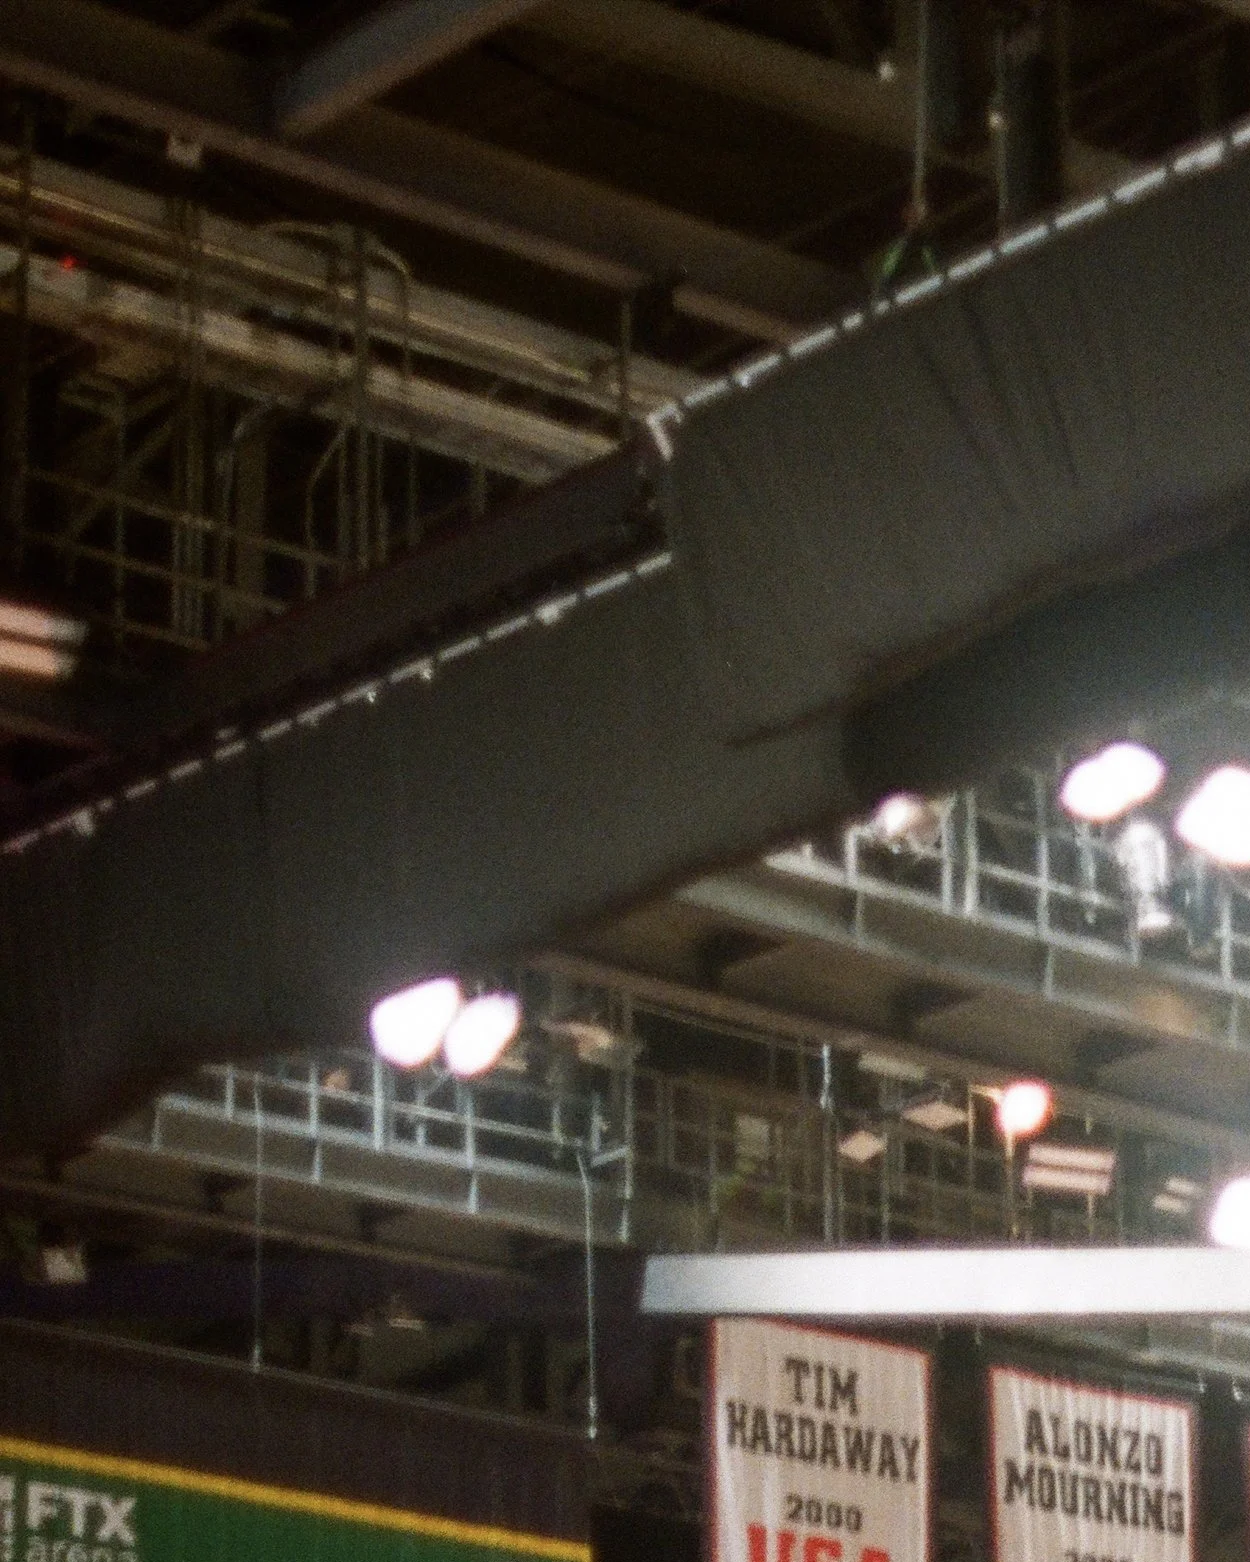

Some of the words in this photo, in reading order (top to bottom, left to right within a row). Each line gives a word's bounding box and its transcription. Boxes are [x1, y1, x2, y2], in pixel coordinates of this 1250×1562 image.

[784, 1354, 860, 1417] TIM
[726, 1398, 921, 1484] HARDAWAY
[1023, 1408, 1164, 1477] ALONZO
[26, 1481, 138, 1547] FTX
[785, 1491, 864, 1534] 2000
[1001, 1457, 1186, 1537] MOURNING
